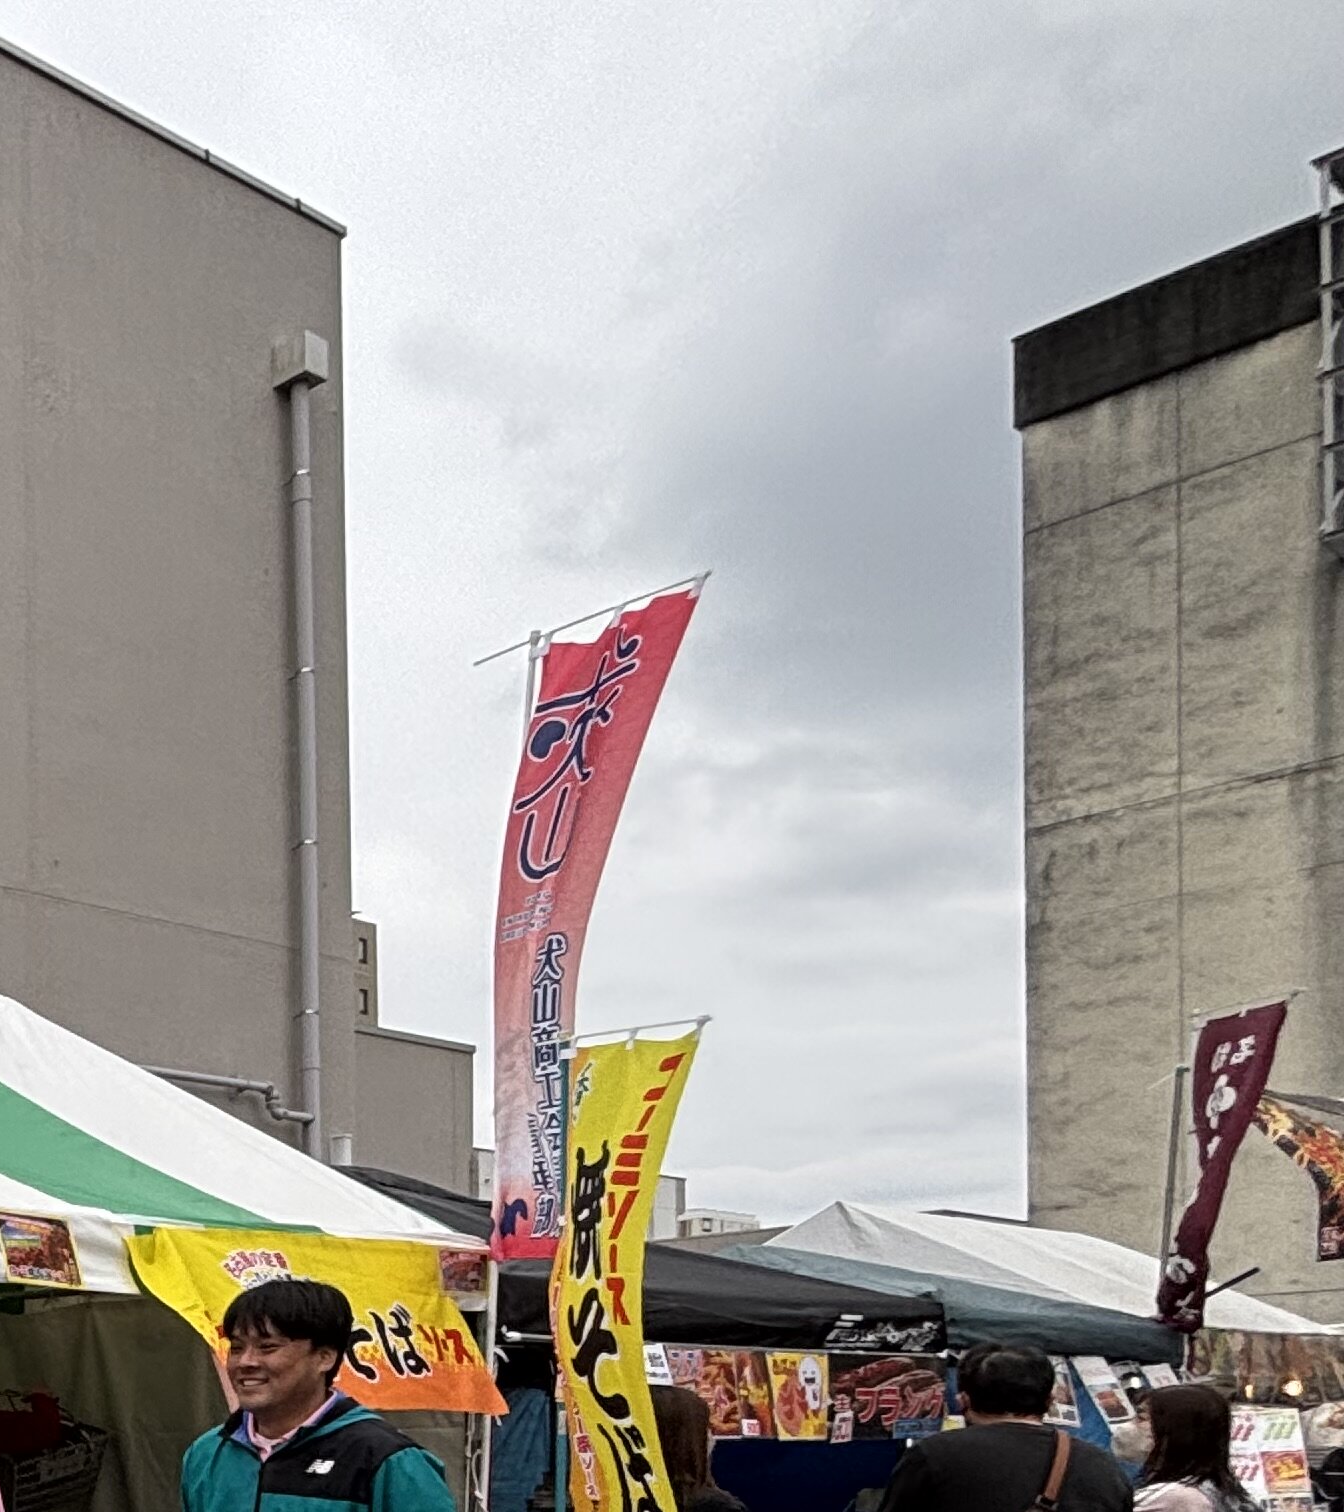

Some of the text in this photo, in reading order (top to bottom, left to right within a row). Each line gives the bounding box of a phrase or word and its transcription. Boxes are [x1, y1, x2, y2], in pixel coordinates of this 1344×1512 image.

[606, 1052, 688, 1326] コーミソース
